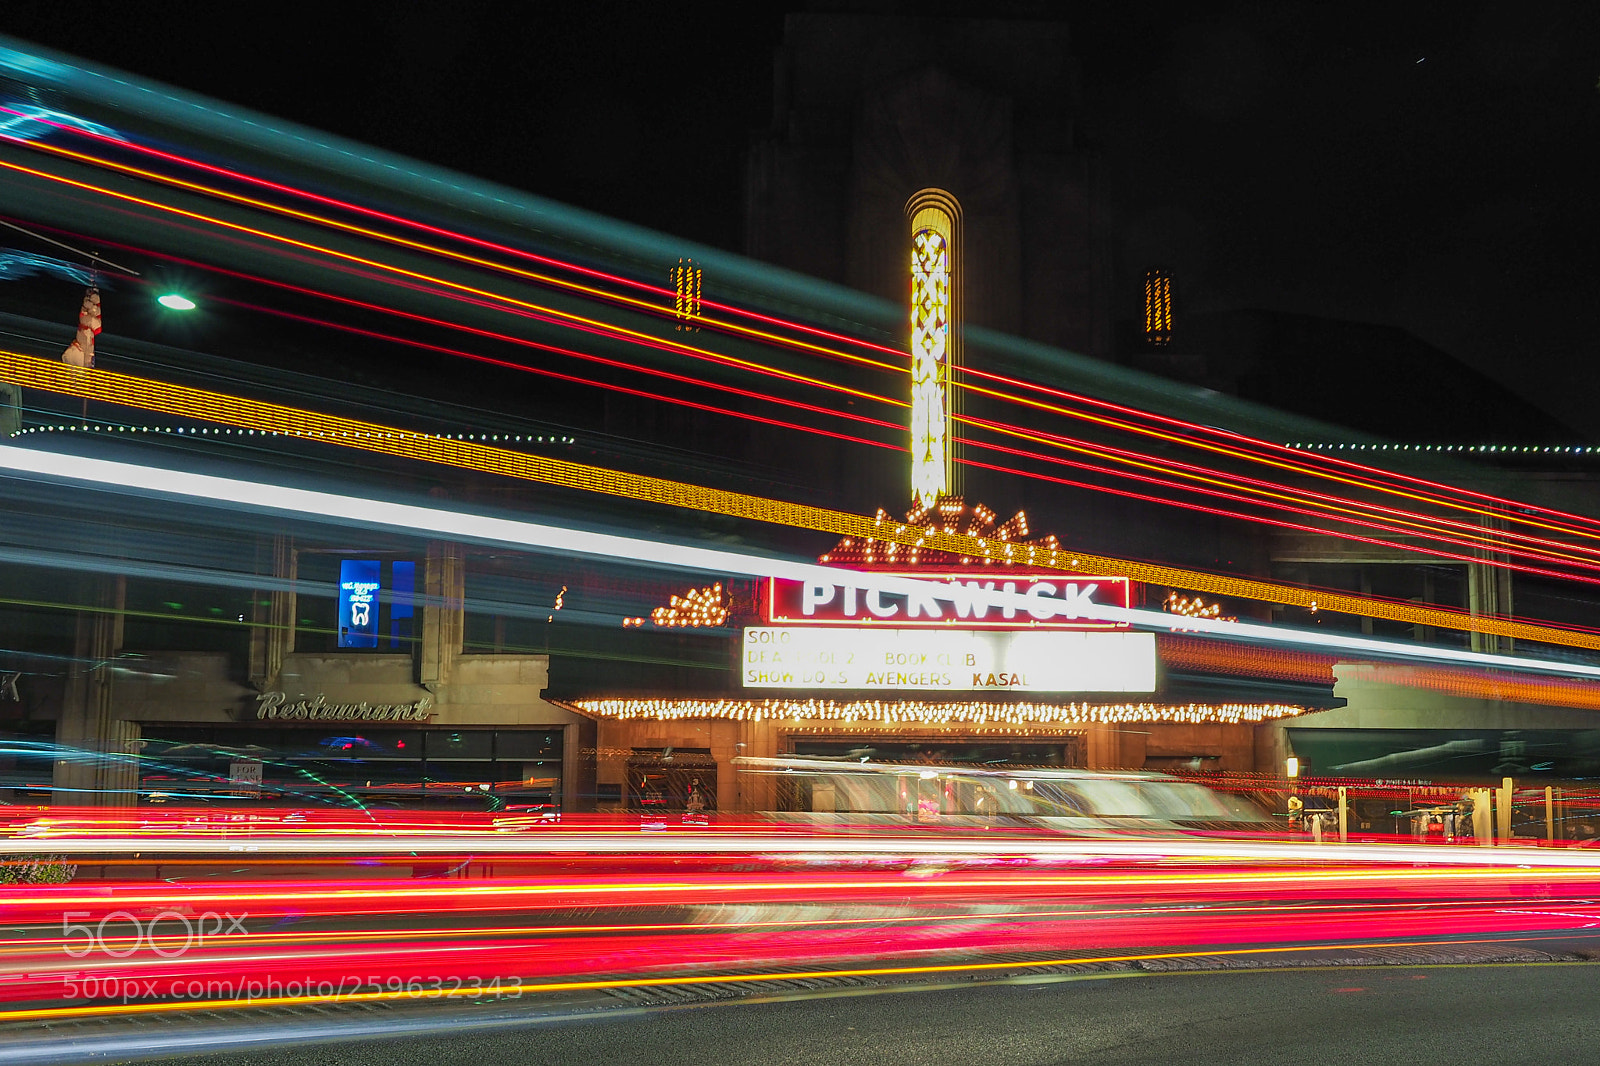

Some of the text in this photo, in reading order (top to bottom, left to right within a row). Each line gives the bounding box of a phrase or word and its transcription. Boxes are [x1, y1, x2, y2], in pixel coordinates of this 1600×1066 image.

[802, 580, 1099, 619] PICKWICK
[747, 630, 791, 644] SOLO
[747, 650, 838, 664] DEAOL
[884, 652, 927, 666] BOOK
[936, 653, 976, 667] CLB
[747, 669, 794, 684] SHOW
[865, 672, 952, 686] AVENGERS
[972, 673, 1030, 687] KASAL
[256, 691, 432, 721] Restaurant
[236, 766, 256, 774] FOR
